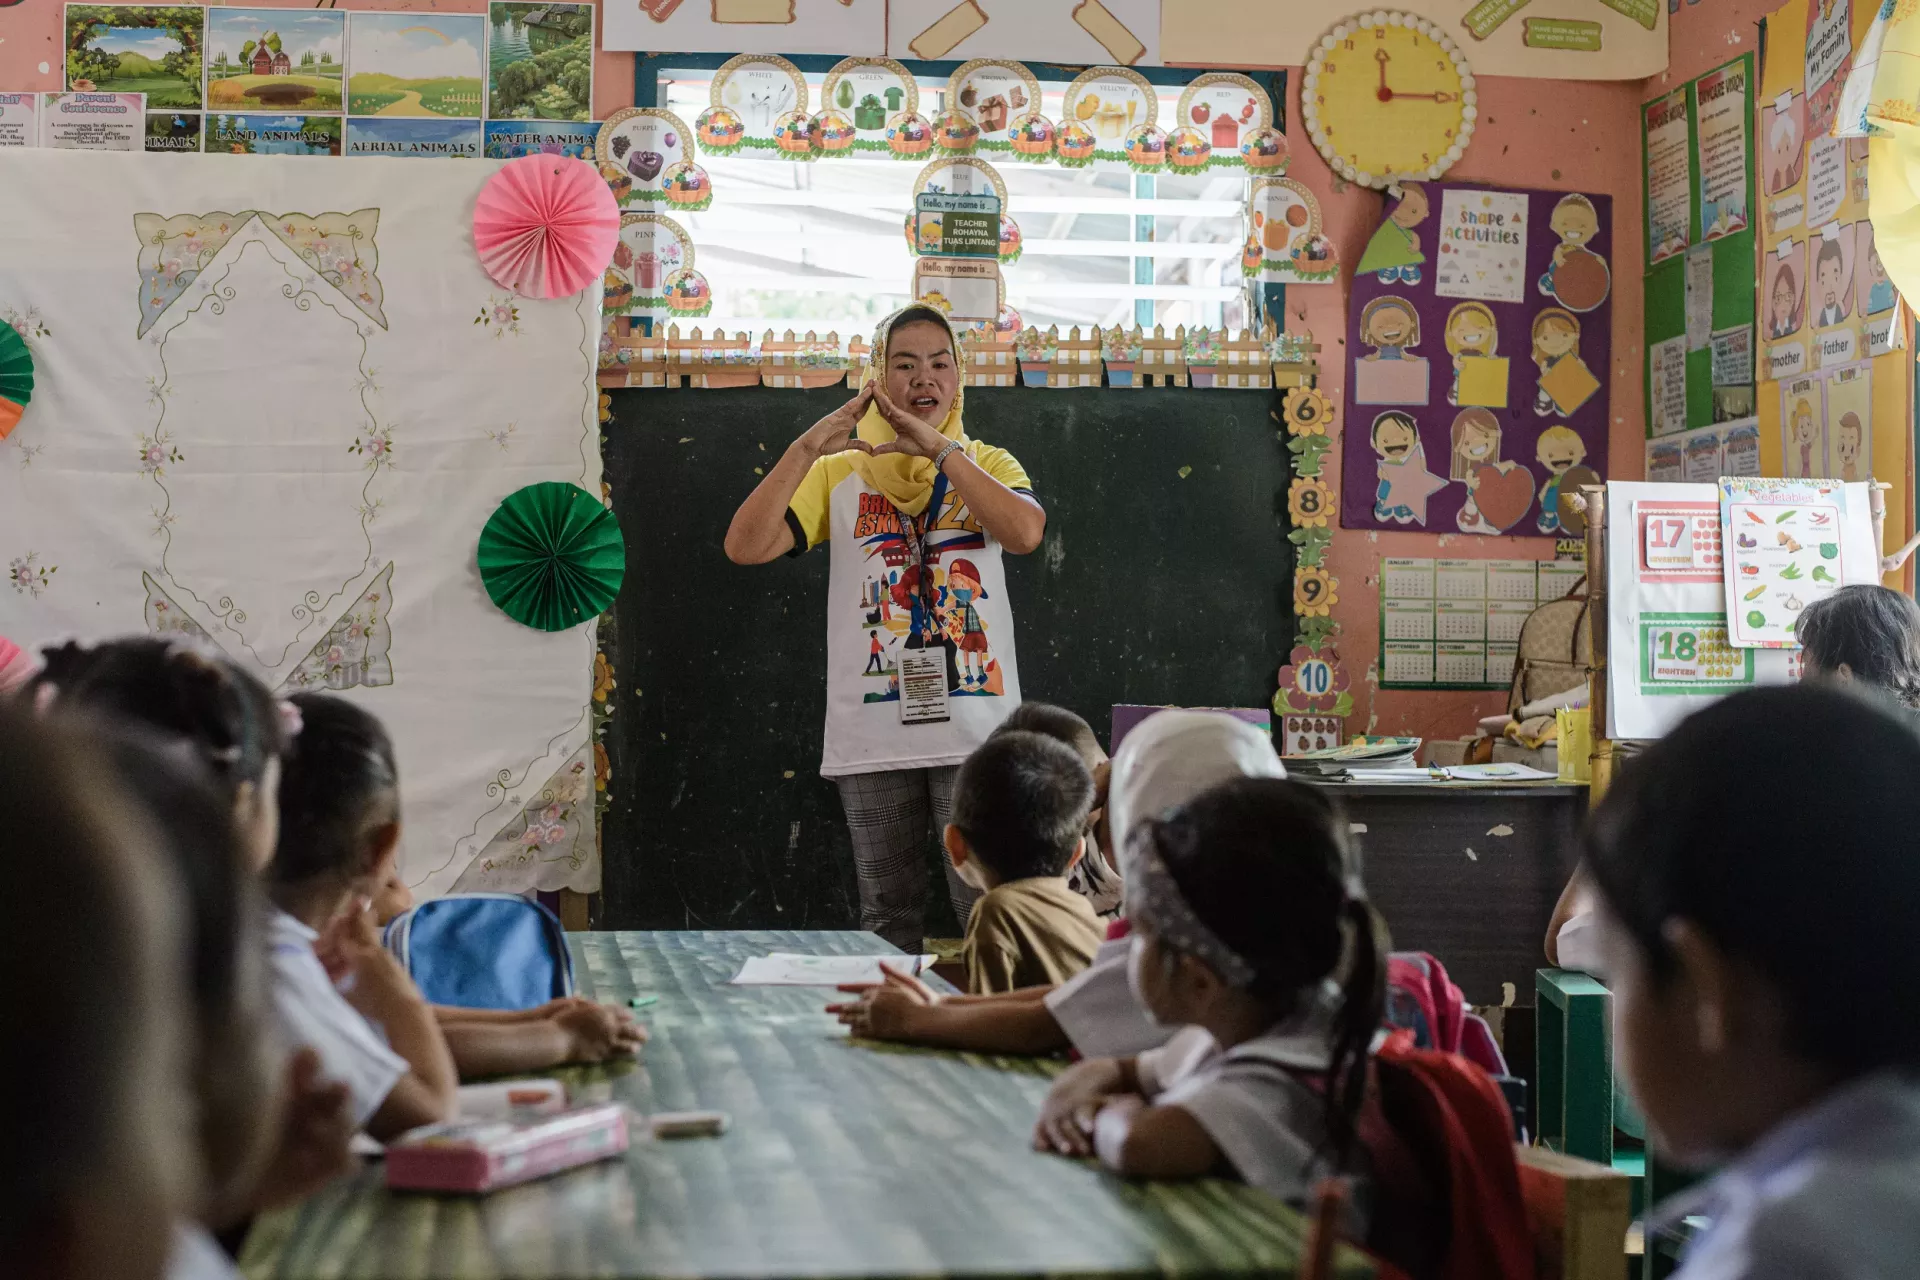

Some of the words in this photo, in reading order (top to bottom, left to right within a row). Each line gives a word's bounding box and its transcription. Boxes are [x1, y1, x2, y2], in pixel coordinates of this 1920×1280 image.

[1413, 36, 1419, 46] 1
[1806, 21, 1837, 65] Members
[1839, 5, 1848, 27] of
[1810, 59, 1820, 78] My
[1821, 31, 1846, 65] Family
[1324, 62, 1336, 74] 10
[1437, 61, 1445, 72] 2
[749, 71, 773, 79] WHITE
[1100, 84, 1127, 93] YELLOW
[75, 92, 117, 103] Parent
[1318, 96, 1325, 107] 9
[60, 102, 128, 114] Conference
[215, 129, 257, 141] LAND
[262, 130, 330, 144] ANIMALS
[490, 133, 542, 145] WATER
[544, 134, 595, 146] ANIMA
[351, 140, 406, 153] AERIAL
[409, 142, 476, 154] ANIMALS
[1351, 154, 1358, 165] 7
[1422, 153, 1429, 164] 5
[952, 172, 970, 181] BLUE
[923, 199, 943, 209] Hello,
[944, 201, 956, 212] my
[957, 201, 979, 210] name
[979, 200, 986, 210] is
[954, 219, 988, 228] TEACHER
[1460, 209, 1505, 227] Shape
[635, 231, 657, 239] PINK
[953, 228, 989, 237] ROHAYNA
[1444, 225, 1520, 245] Activities
[944, 237, 963, 246] TUAS
[964, 237, 996, 247] LINTANG
[923, 262, 943, 273] Hello,
[944, 264, 956, 275] my
[957, 265, 979, 274] name
[979, 264, 986, 274] is
[1823, 340, 1849, 356] father
[1772, 351, 1801, 368] mother
[1296, 397, 1315, 422] 6
[1300, 489, 1319, 514] 8
[1753, 490, 1814, 504] Vegetables
[1649, 519, 1686, 548] 17
[1302, 578, 1321, 602] 9
[1657, 631, 1697, 662] 18
[1301, 662, 1328, 693] 10
[1657, 667, 1696, 676] EIGHTEEN
